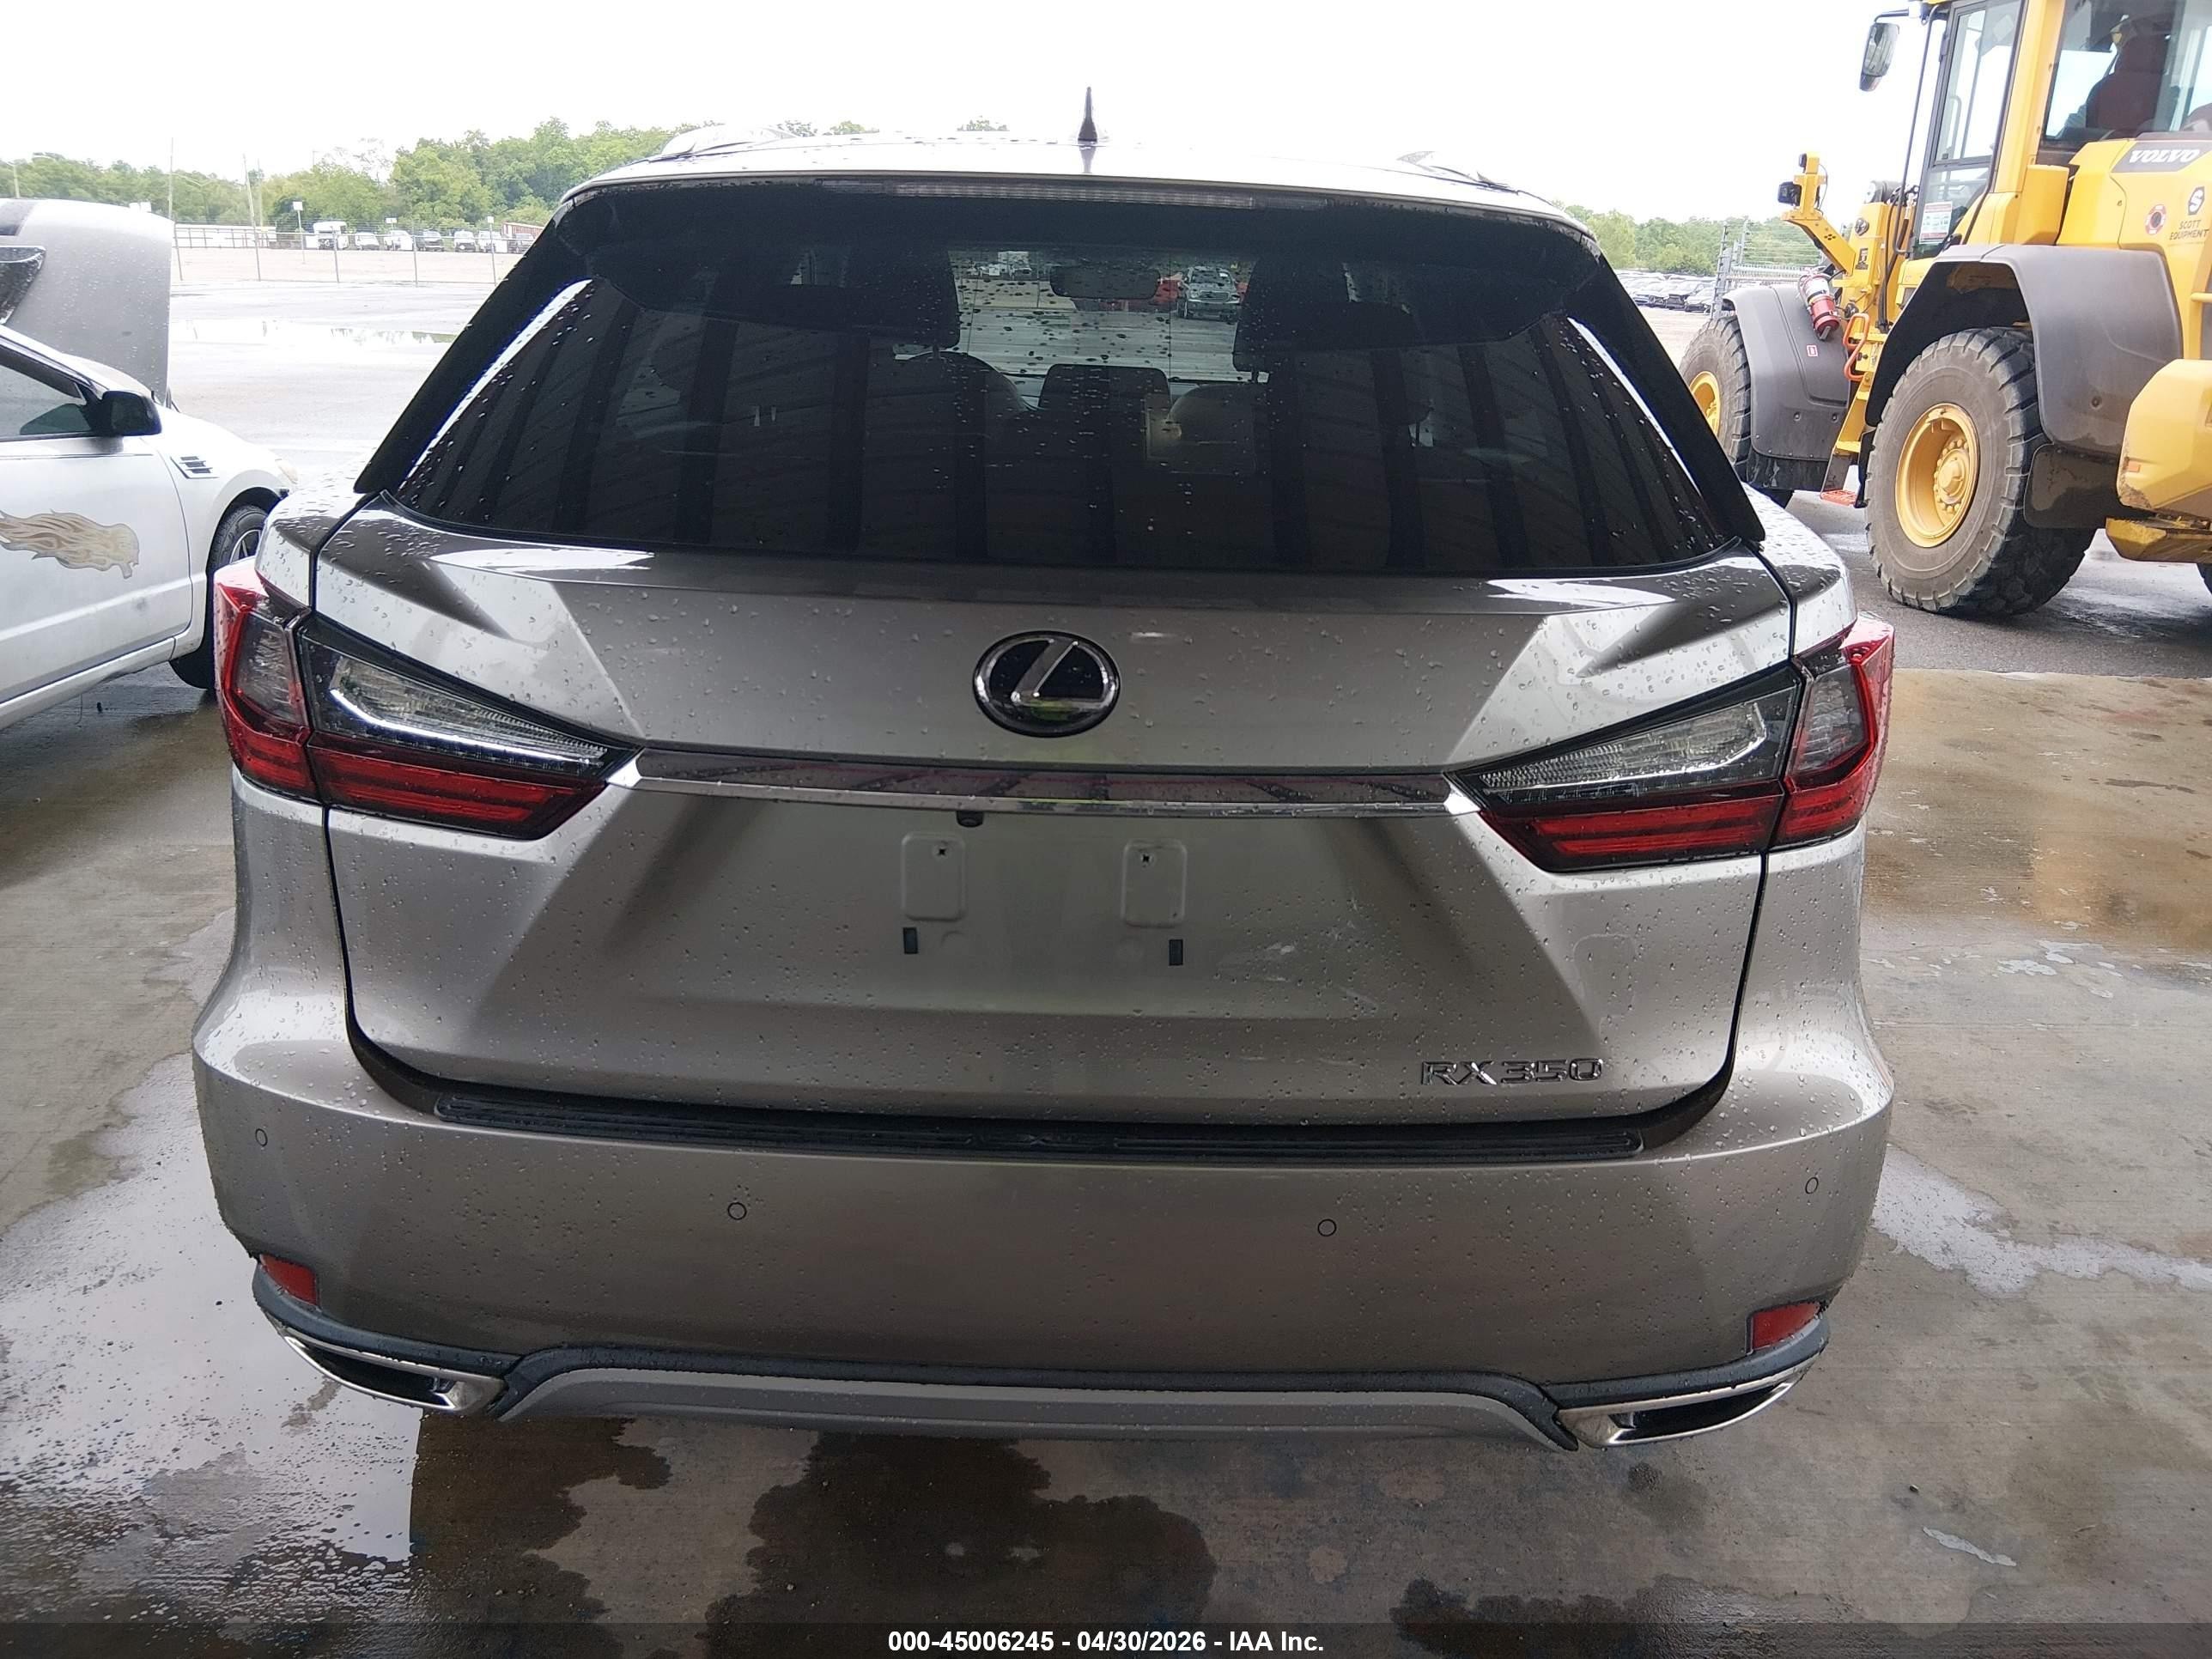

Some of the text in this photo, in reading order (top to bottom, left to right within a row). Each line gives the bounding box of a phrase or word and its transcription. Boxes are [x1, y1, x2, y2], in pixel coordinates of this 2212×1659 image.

[2129, 149, 2201, 163] VOLVO
[2179, 220, 2201, 230] SCOTT
[2169, 229, 2209, 241] EQUIPMENT
